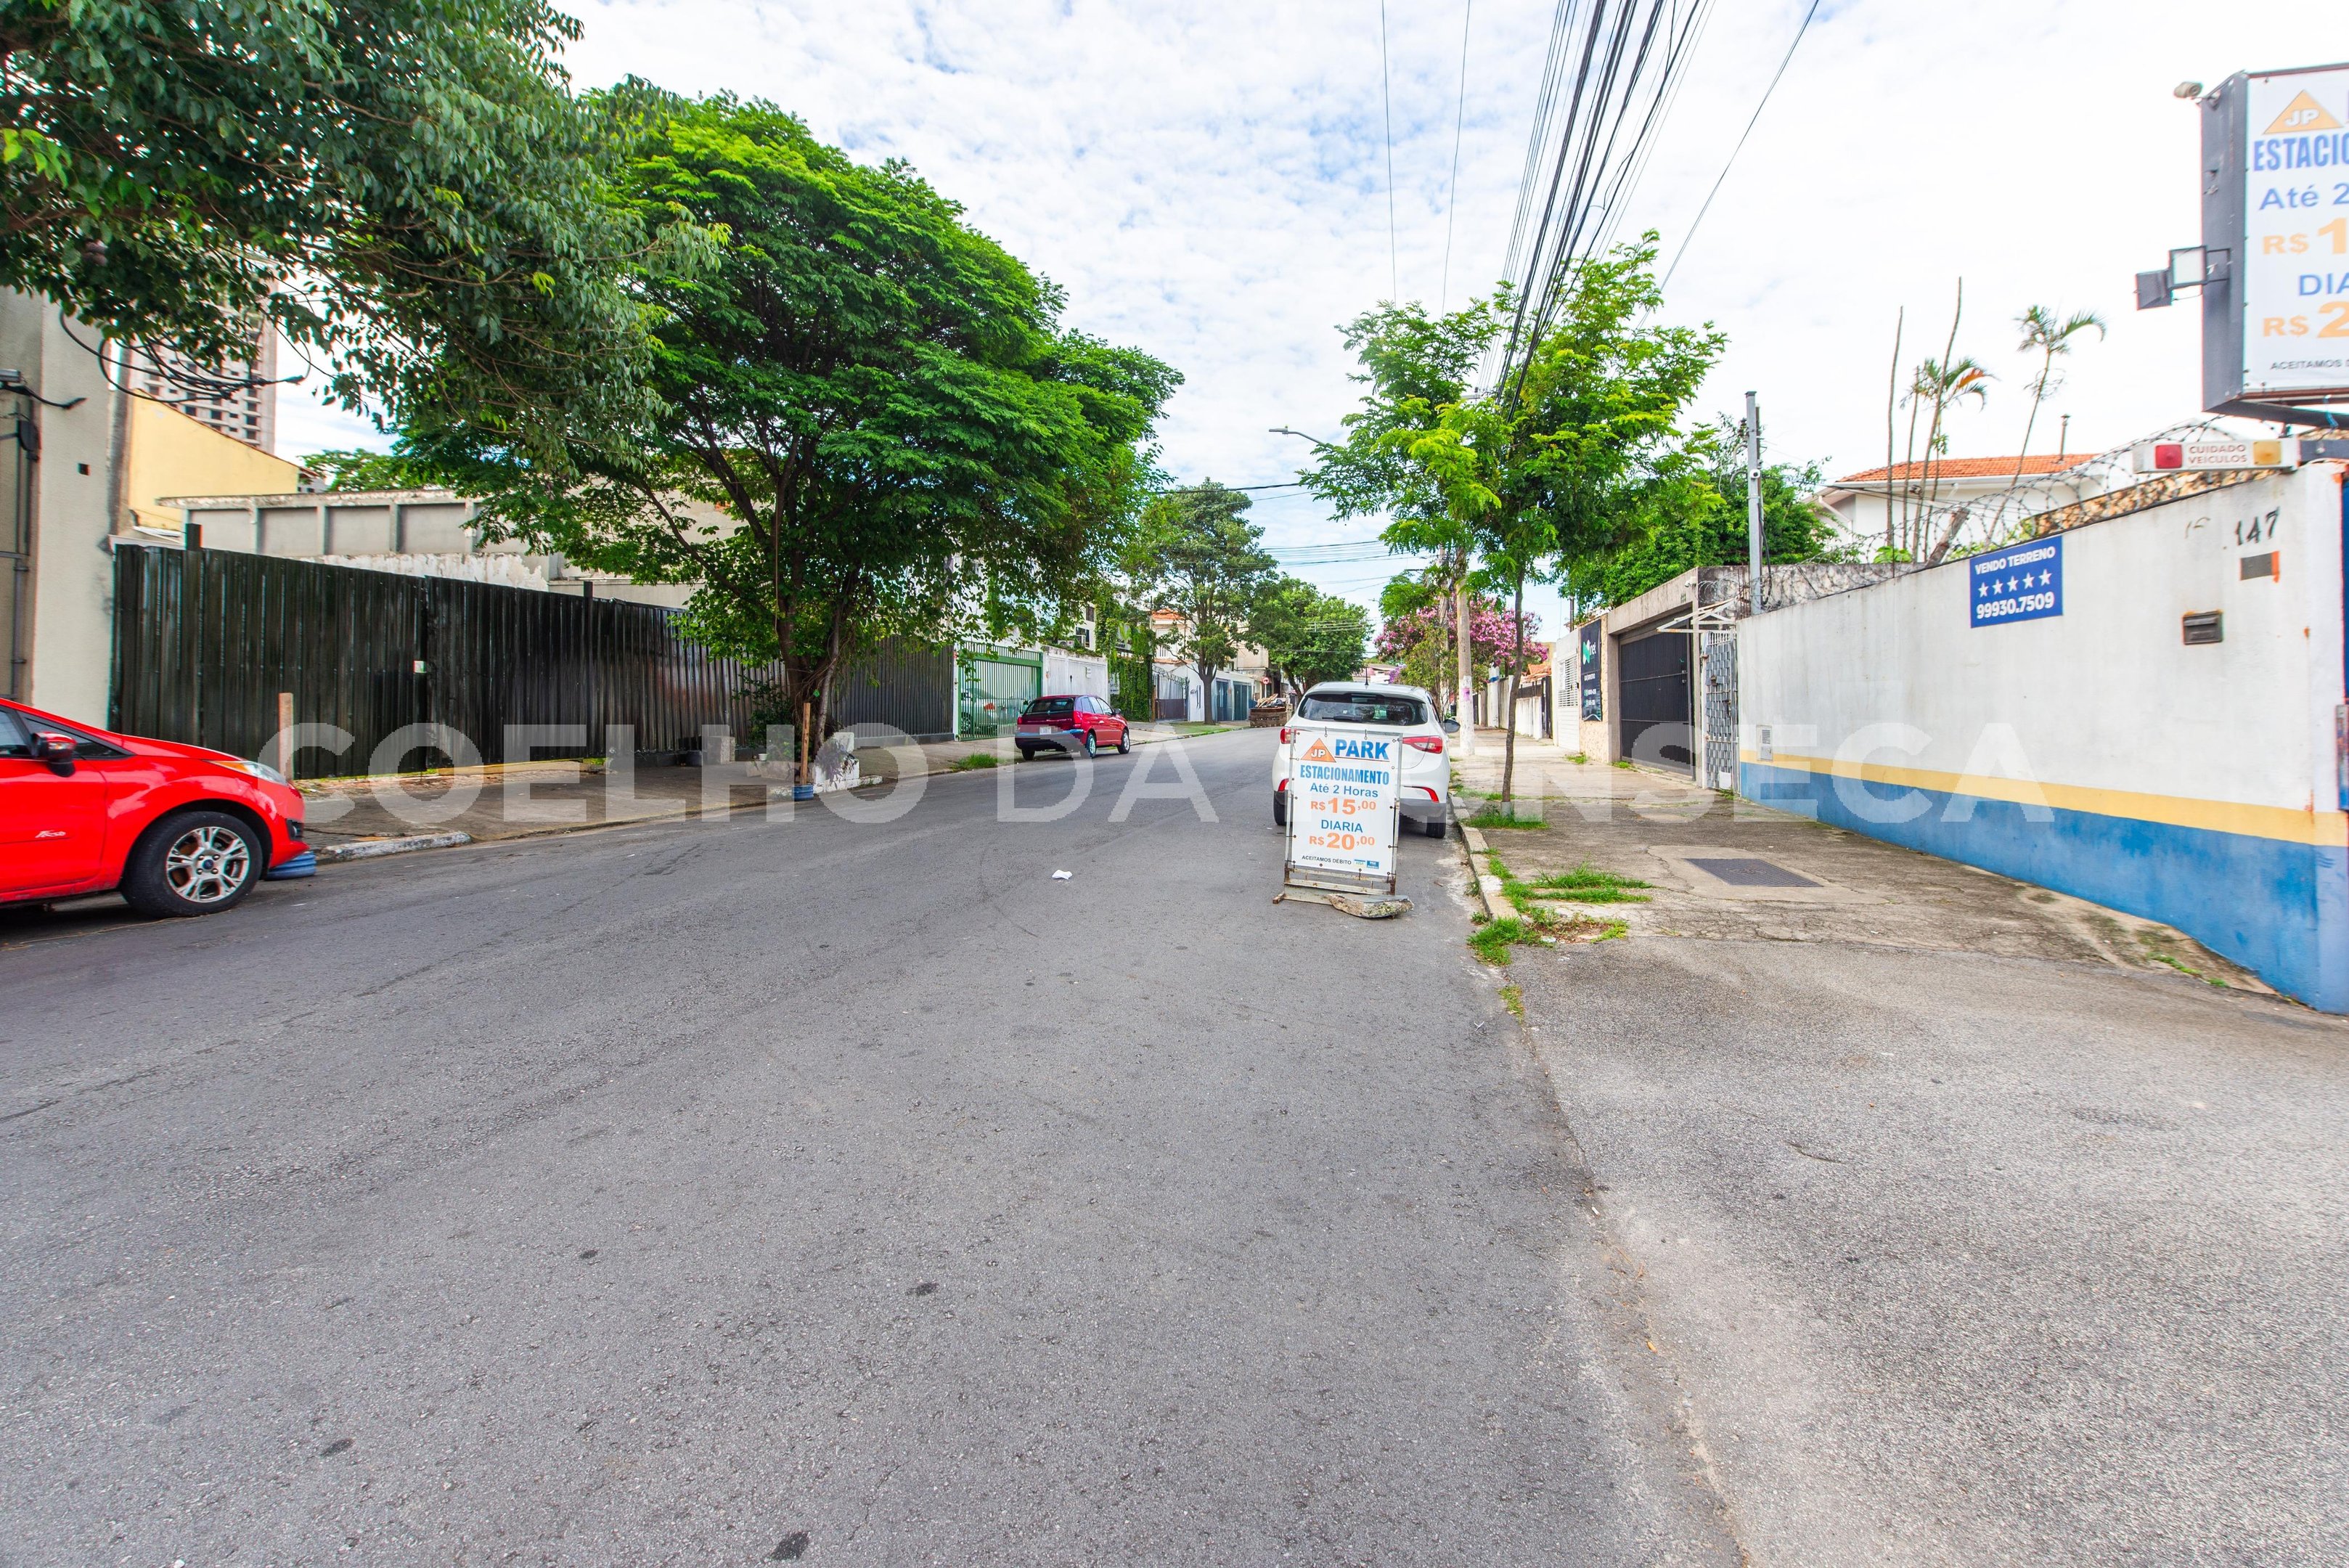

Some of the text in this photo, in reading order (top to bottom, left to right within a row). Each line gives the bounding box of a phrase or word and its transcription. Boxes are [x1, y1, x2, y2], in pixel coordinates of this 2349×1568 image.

[2284, 109, 2320, 126] JP
[2259, 184, 2319, 211] Até
[2271, 359, 2342, 369] ACEITAMOS
[2189, 444, 2246, 454] CUIDADO
[2235, 507, 2280, 545] 147
[1974, 546, 2056, 575] VENDO TERRENO
[1976, 592, 2055, 619] 99930.7509
[1310, 739, 1389, 760] JP PARK
[1300, 764, 1389, 785] ESTACIONAMENTO
[1310, 783, 1378, 797] Até 2 Horas
[1321, 820, 1363, 833] DIARIA
